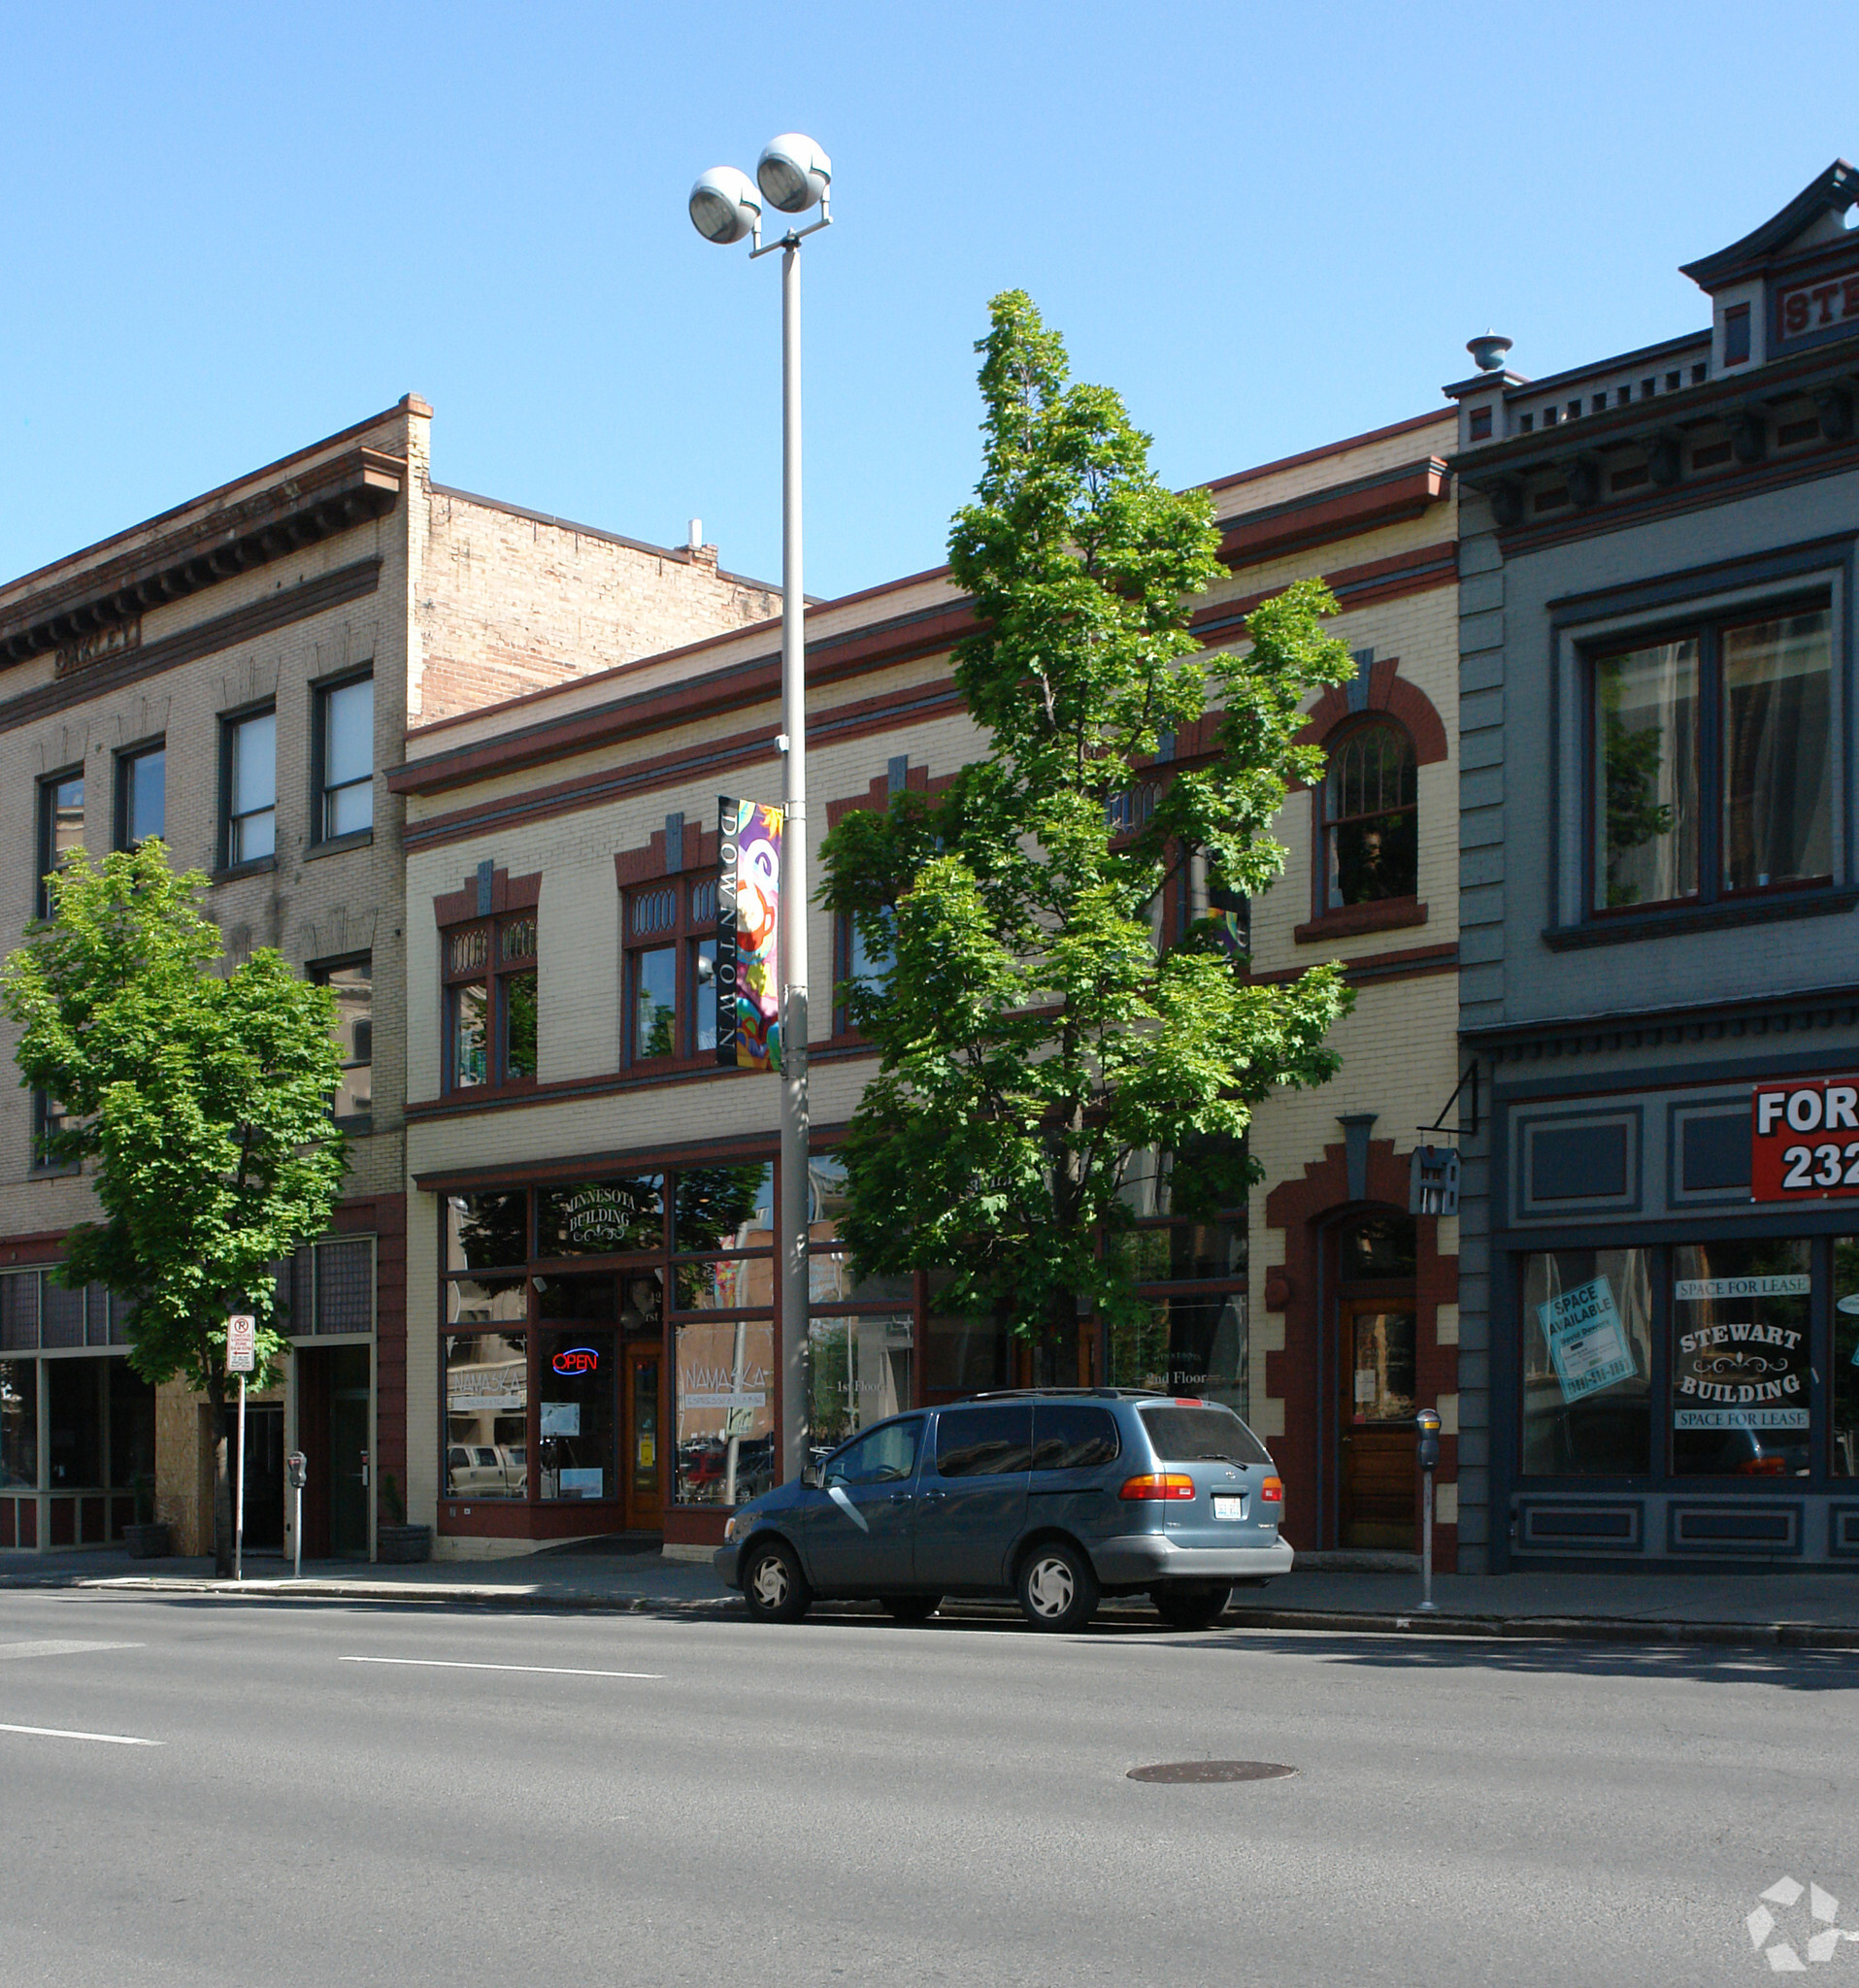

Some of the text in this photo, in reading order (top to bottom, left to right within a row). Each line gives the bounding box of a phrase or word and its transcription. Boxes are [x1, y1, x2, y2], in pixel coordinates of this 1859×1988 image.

[56, 622, 137, 669] OAKLEY
[720, 813, 738, 1049] DOWNTOWN
[1758, 1086, 1859, 1134] FOR
[1782, 1142, 1859, 1188] 232
[565, 1188, 636, 1213] MINNESOTA
[569, 1208, 629, 1232] BUILDING
[1554, 1285, 1599, 1315] SPACE
[1680, 1277, 1807, 1296] SPACE FOR LEASE
[1549, 1297, 1611, 1336] AVAILABLE
[1679, 1323, 1803, 1353] STEWART
[552, 1353, 597, 1370] OPEN
[855, 1379, 881, 1392] Floor
[1146, 1371, 1207, 1385] 2nd Floor
[1679, 1374, 1801, 1403] BUILDING
[1680, 1411, 1807, 1426] SPACE FOR LEASE
